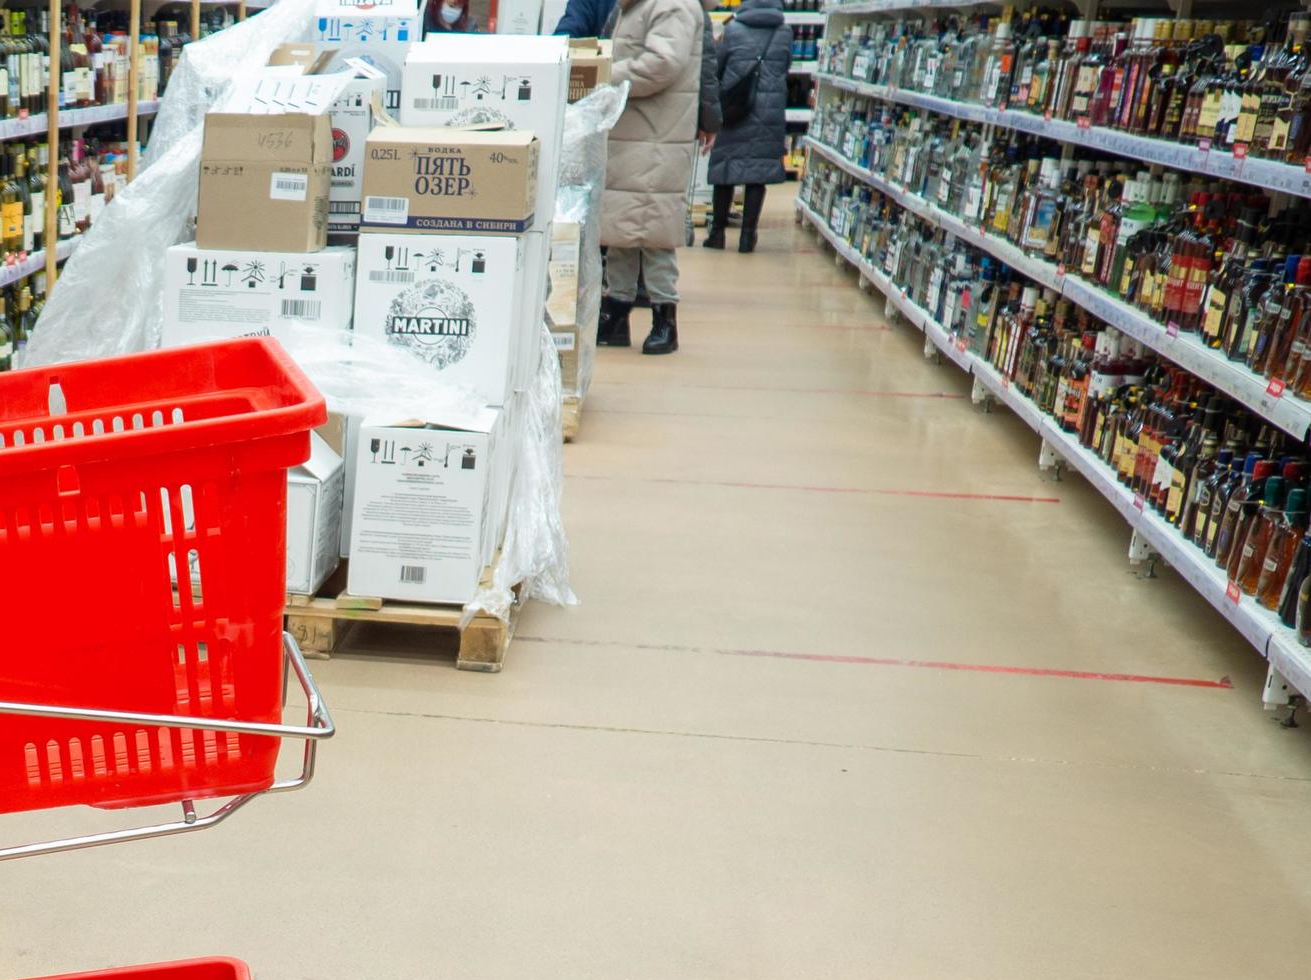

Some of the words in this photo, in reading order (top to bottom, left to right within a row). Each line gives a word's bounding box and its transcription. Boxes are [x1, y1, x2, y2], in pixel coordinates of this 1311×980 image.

[428, 146, 462, 155] ВОДКА
[416, 156, 471, 176] ПЯТЬ
[415, 176, 470, 196] ОЗЕР
[416, 218, 463, 229] СОЗДАНА
[467, 220, 474, 229] В
[476, 221, 517, 231] СИБИРИ
[393, 317, 467, 335] MARTINI
